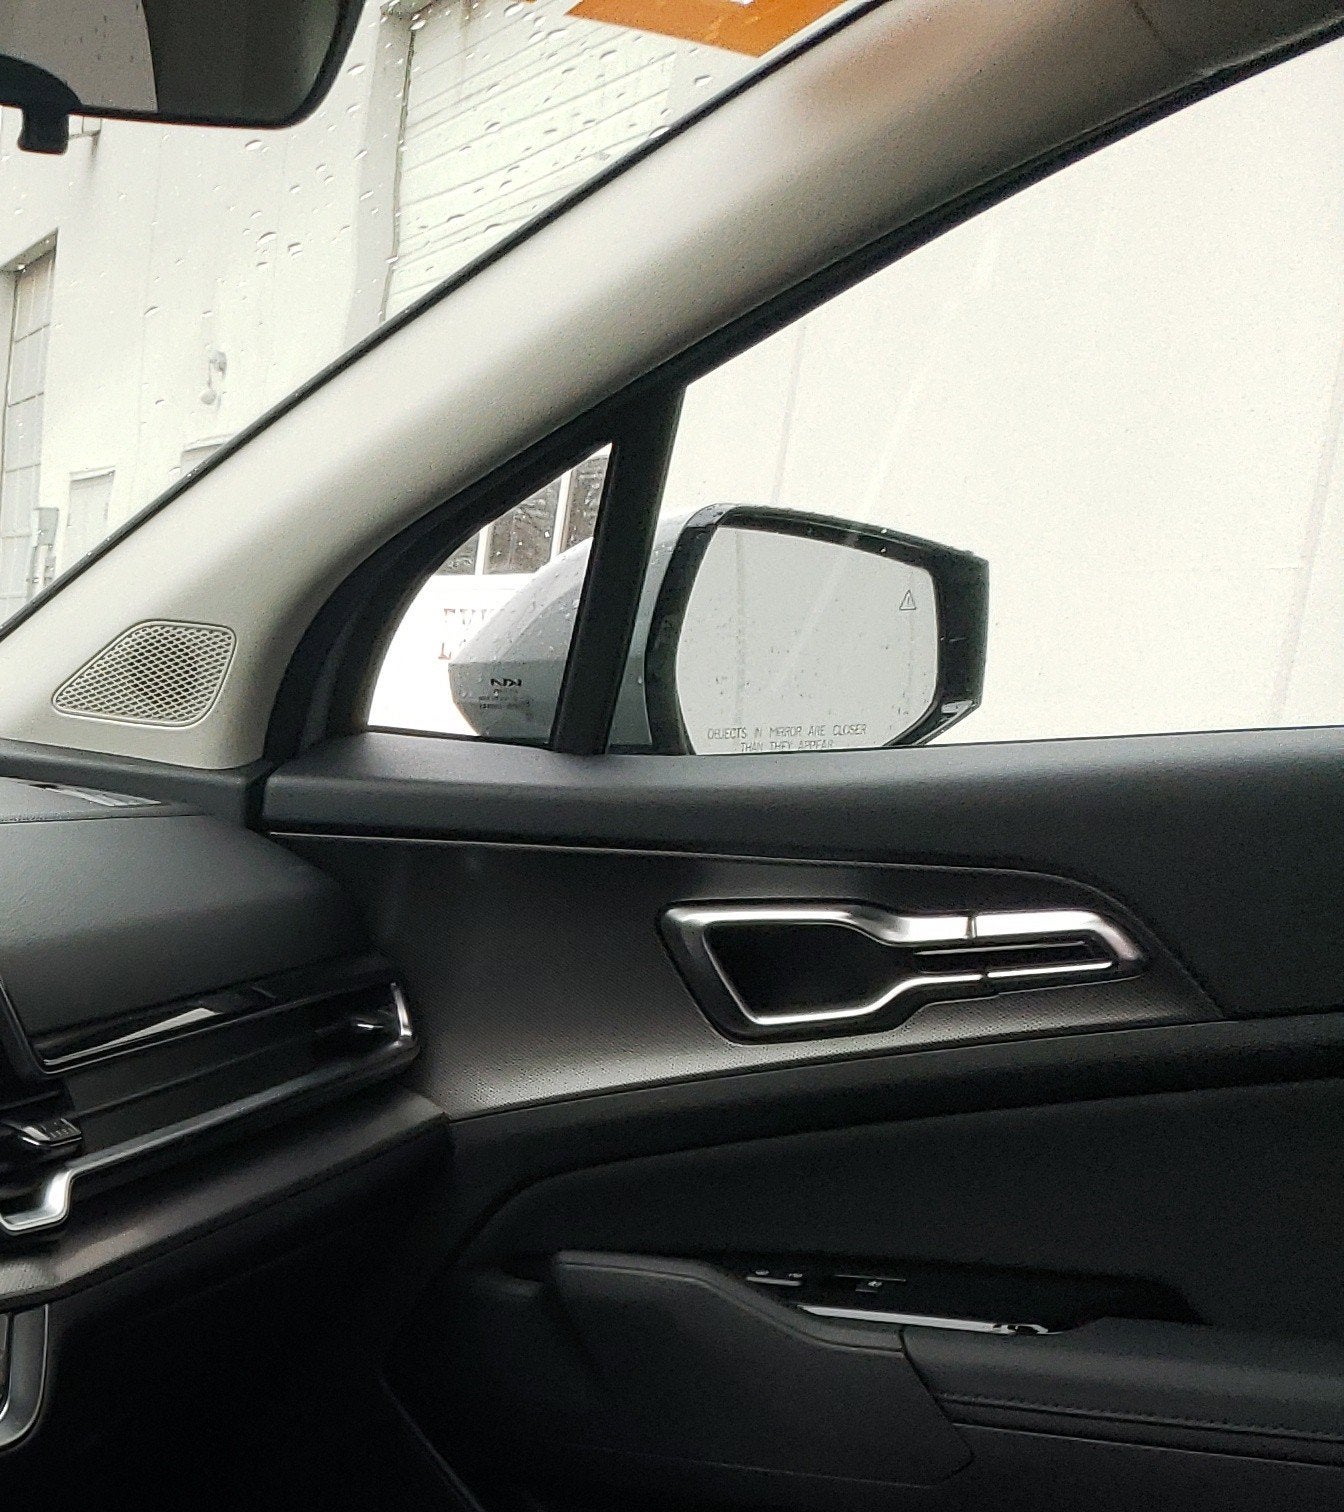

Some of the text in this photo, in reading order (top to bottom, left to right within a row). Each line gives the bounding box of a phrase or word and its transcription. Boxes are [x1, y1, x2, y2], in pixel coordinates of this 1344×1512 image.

[707, 728, 747, 739] OBJECTS
[769, 726, 803, 738] MIRROR
[808, 725, 825, 737] ARE
[833, 724, 867, 736] CLOSER
